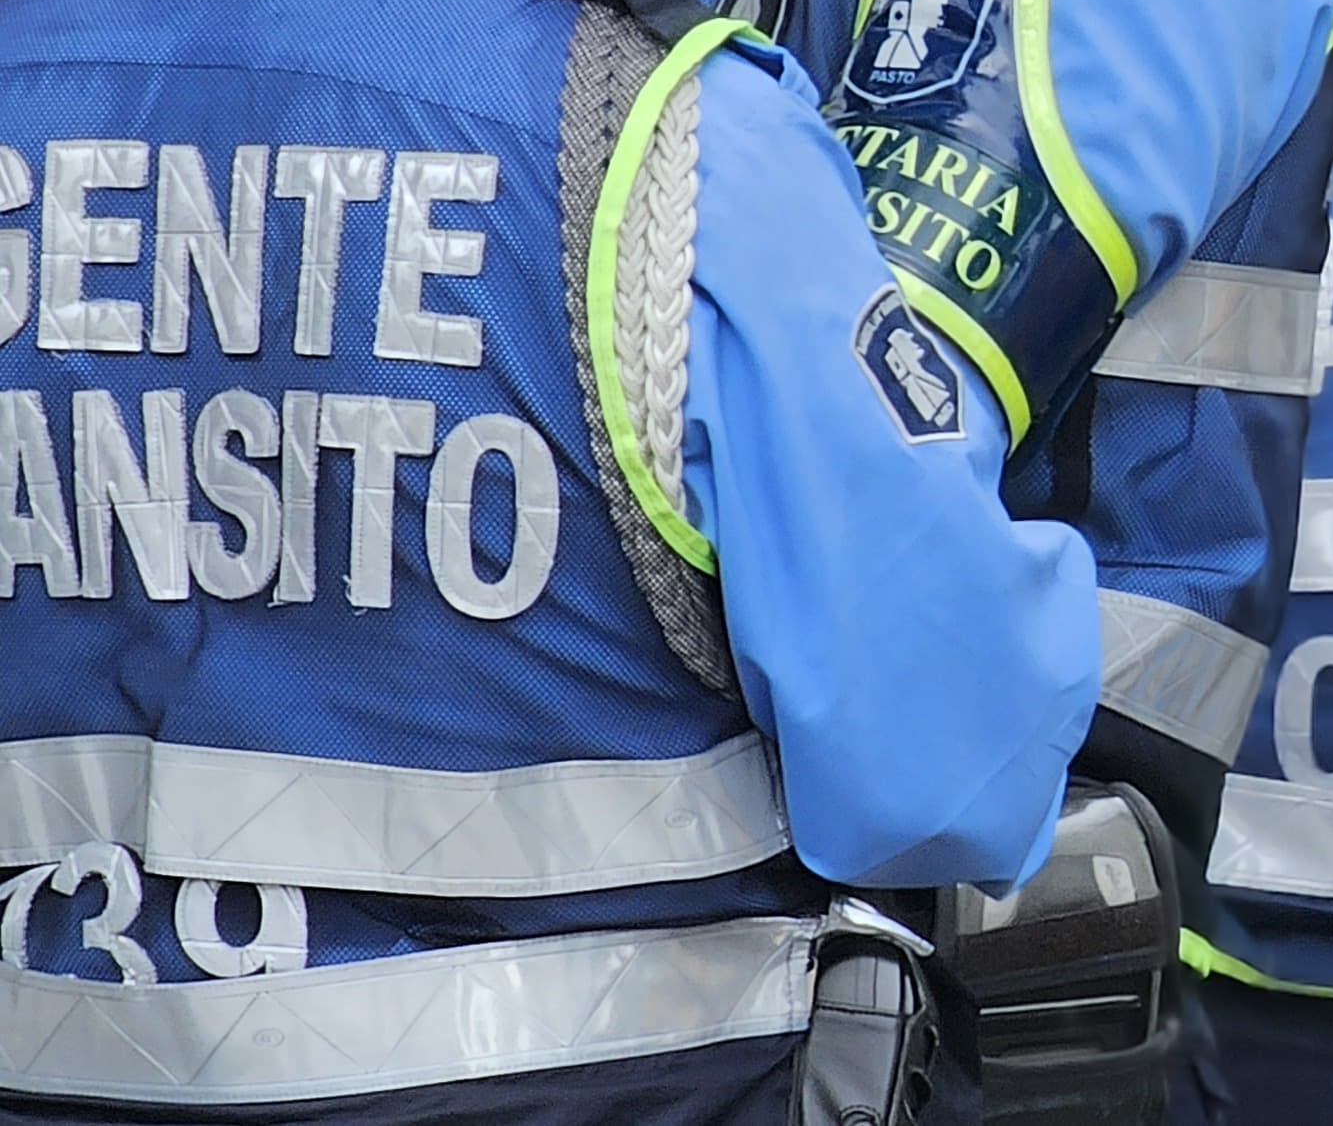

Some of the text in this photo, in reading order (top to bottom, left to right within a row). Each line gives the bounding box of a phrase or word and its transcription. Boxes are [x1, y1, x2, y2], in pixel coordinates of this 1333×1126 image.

[869, 69, 917, 85] PASTO
[838, 124, 1020, 236] TARIA
[864, 185, 1002, 291] SITO
[0, 387, 561, 620] ANSITO
